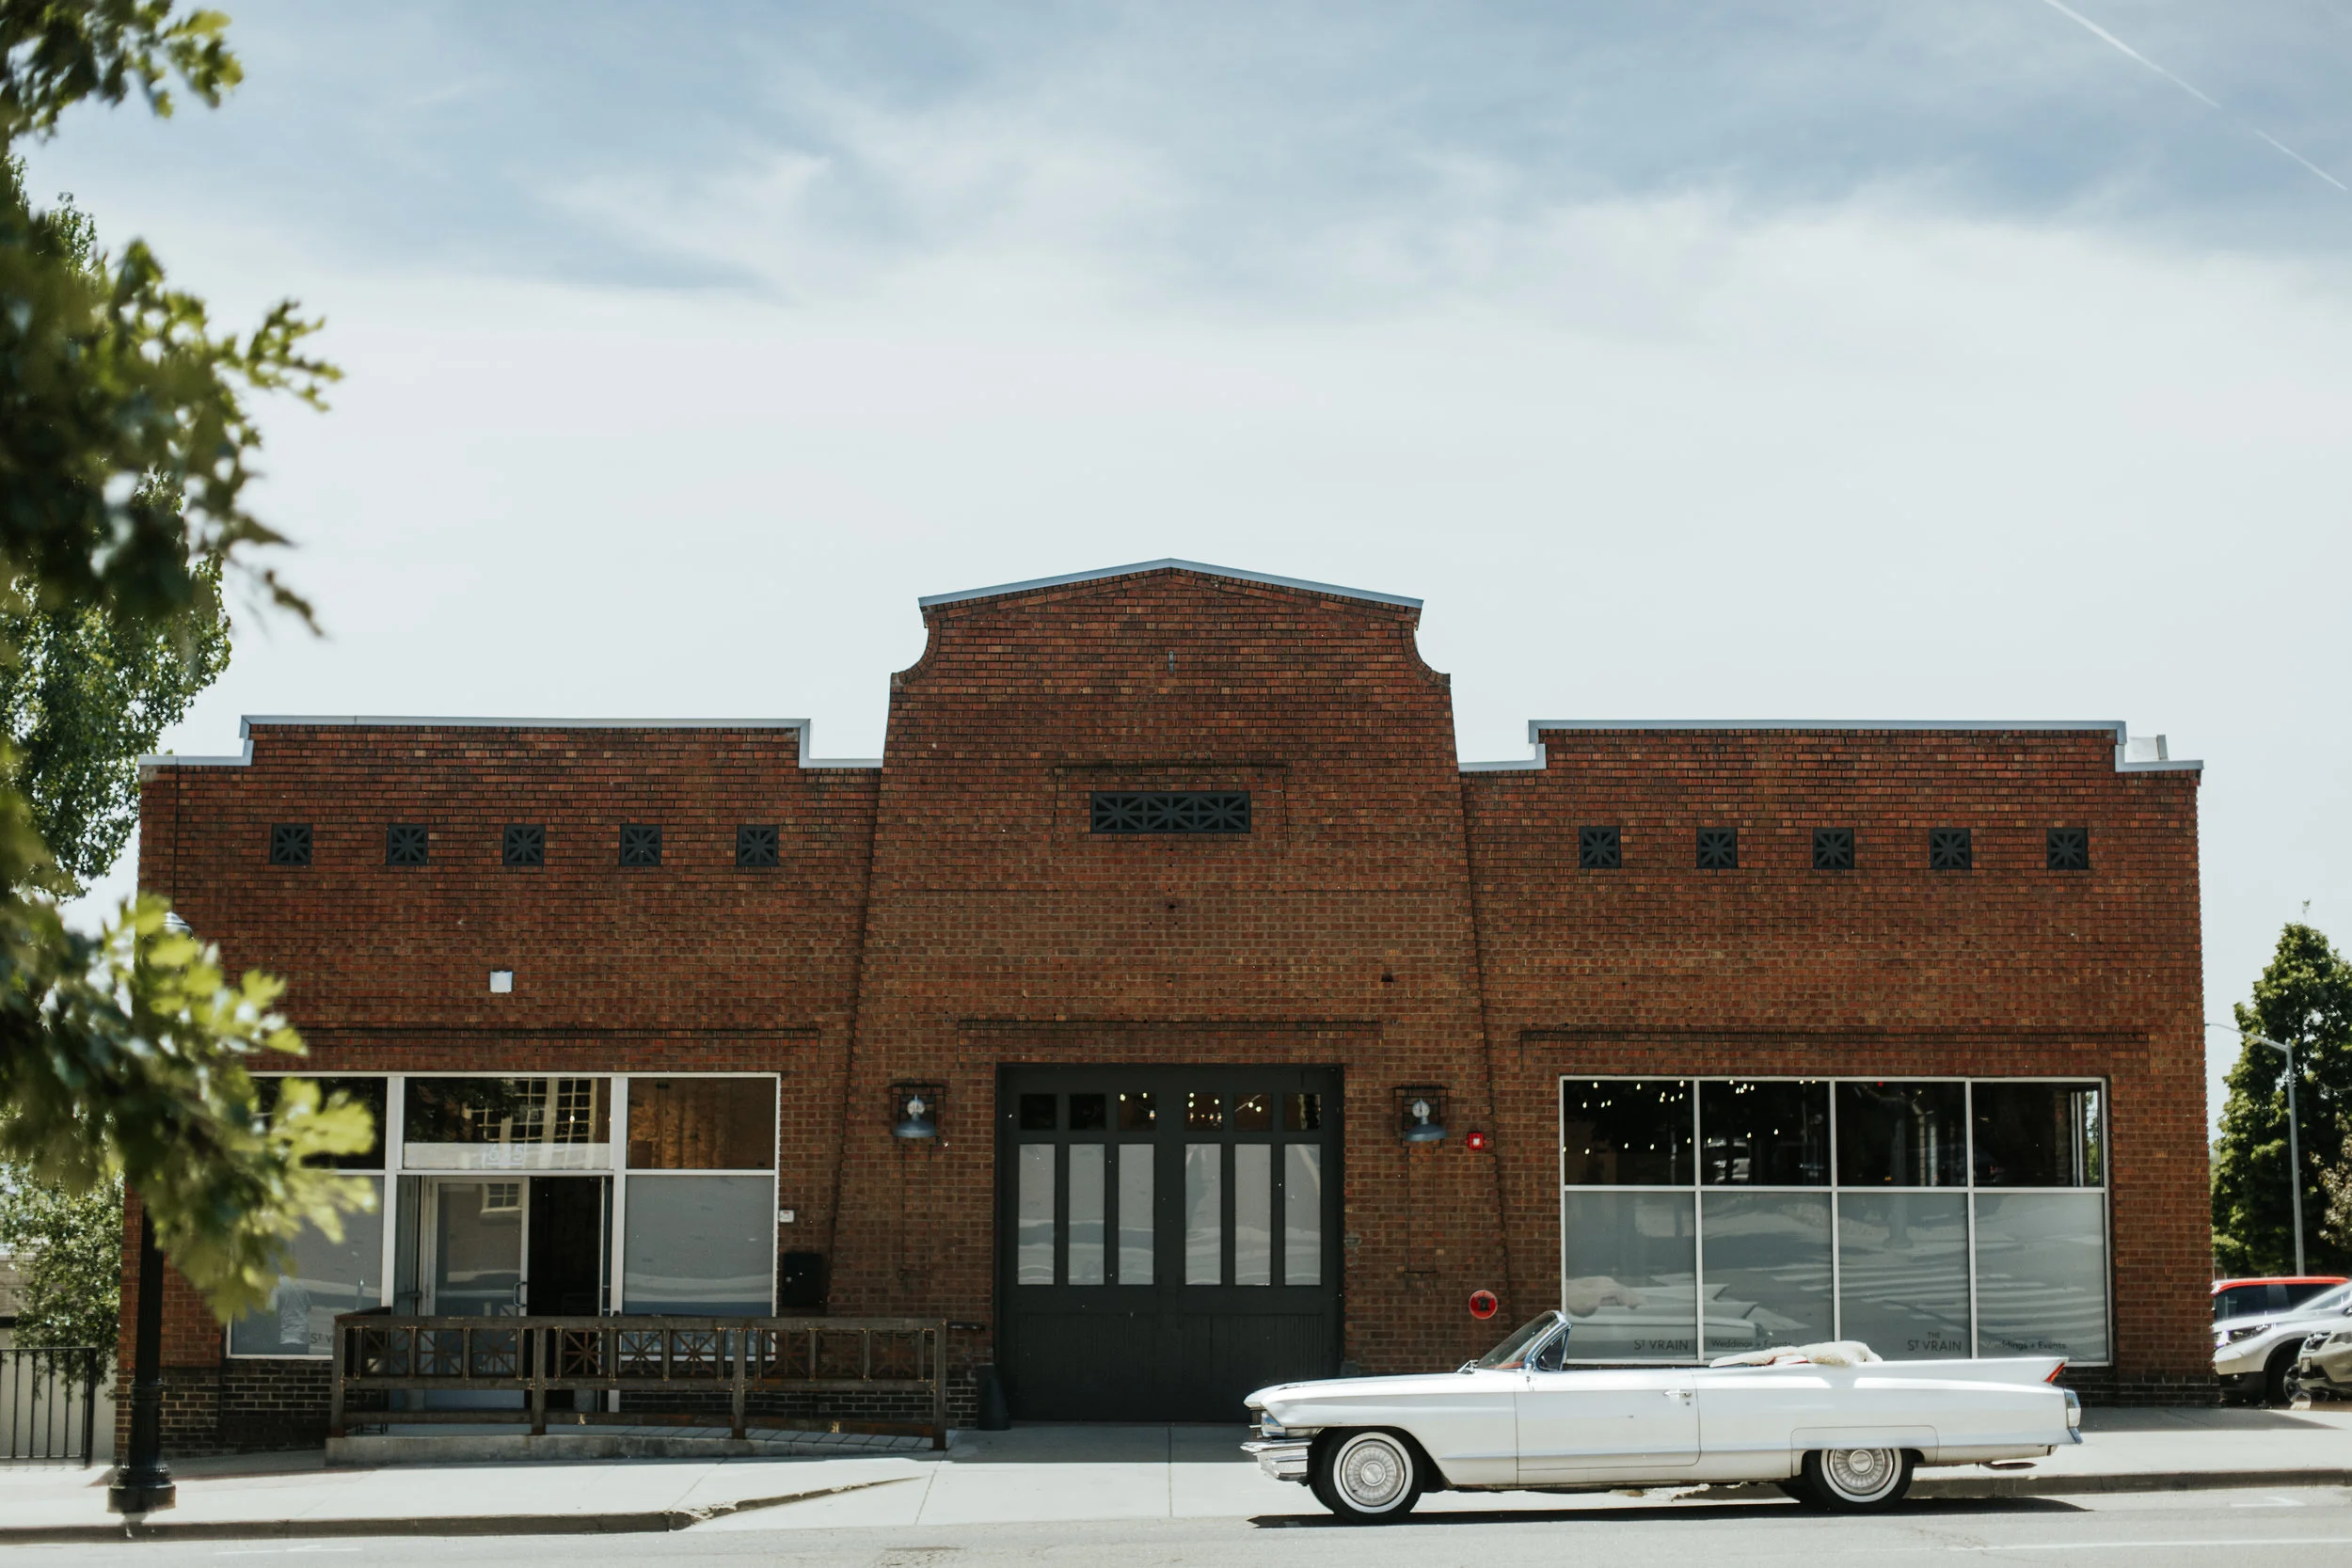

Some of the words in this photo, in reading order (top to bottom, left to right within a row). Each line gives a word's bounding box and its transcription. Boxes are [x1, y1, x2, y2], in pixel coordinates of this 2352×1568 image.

[1927, 1331, 1941, 1339] THE
[1648, 1339, 1689, 1351] VRAIN
[1922, 1339, 1962, 1352] VRAIN
